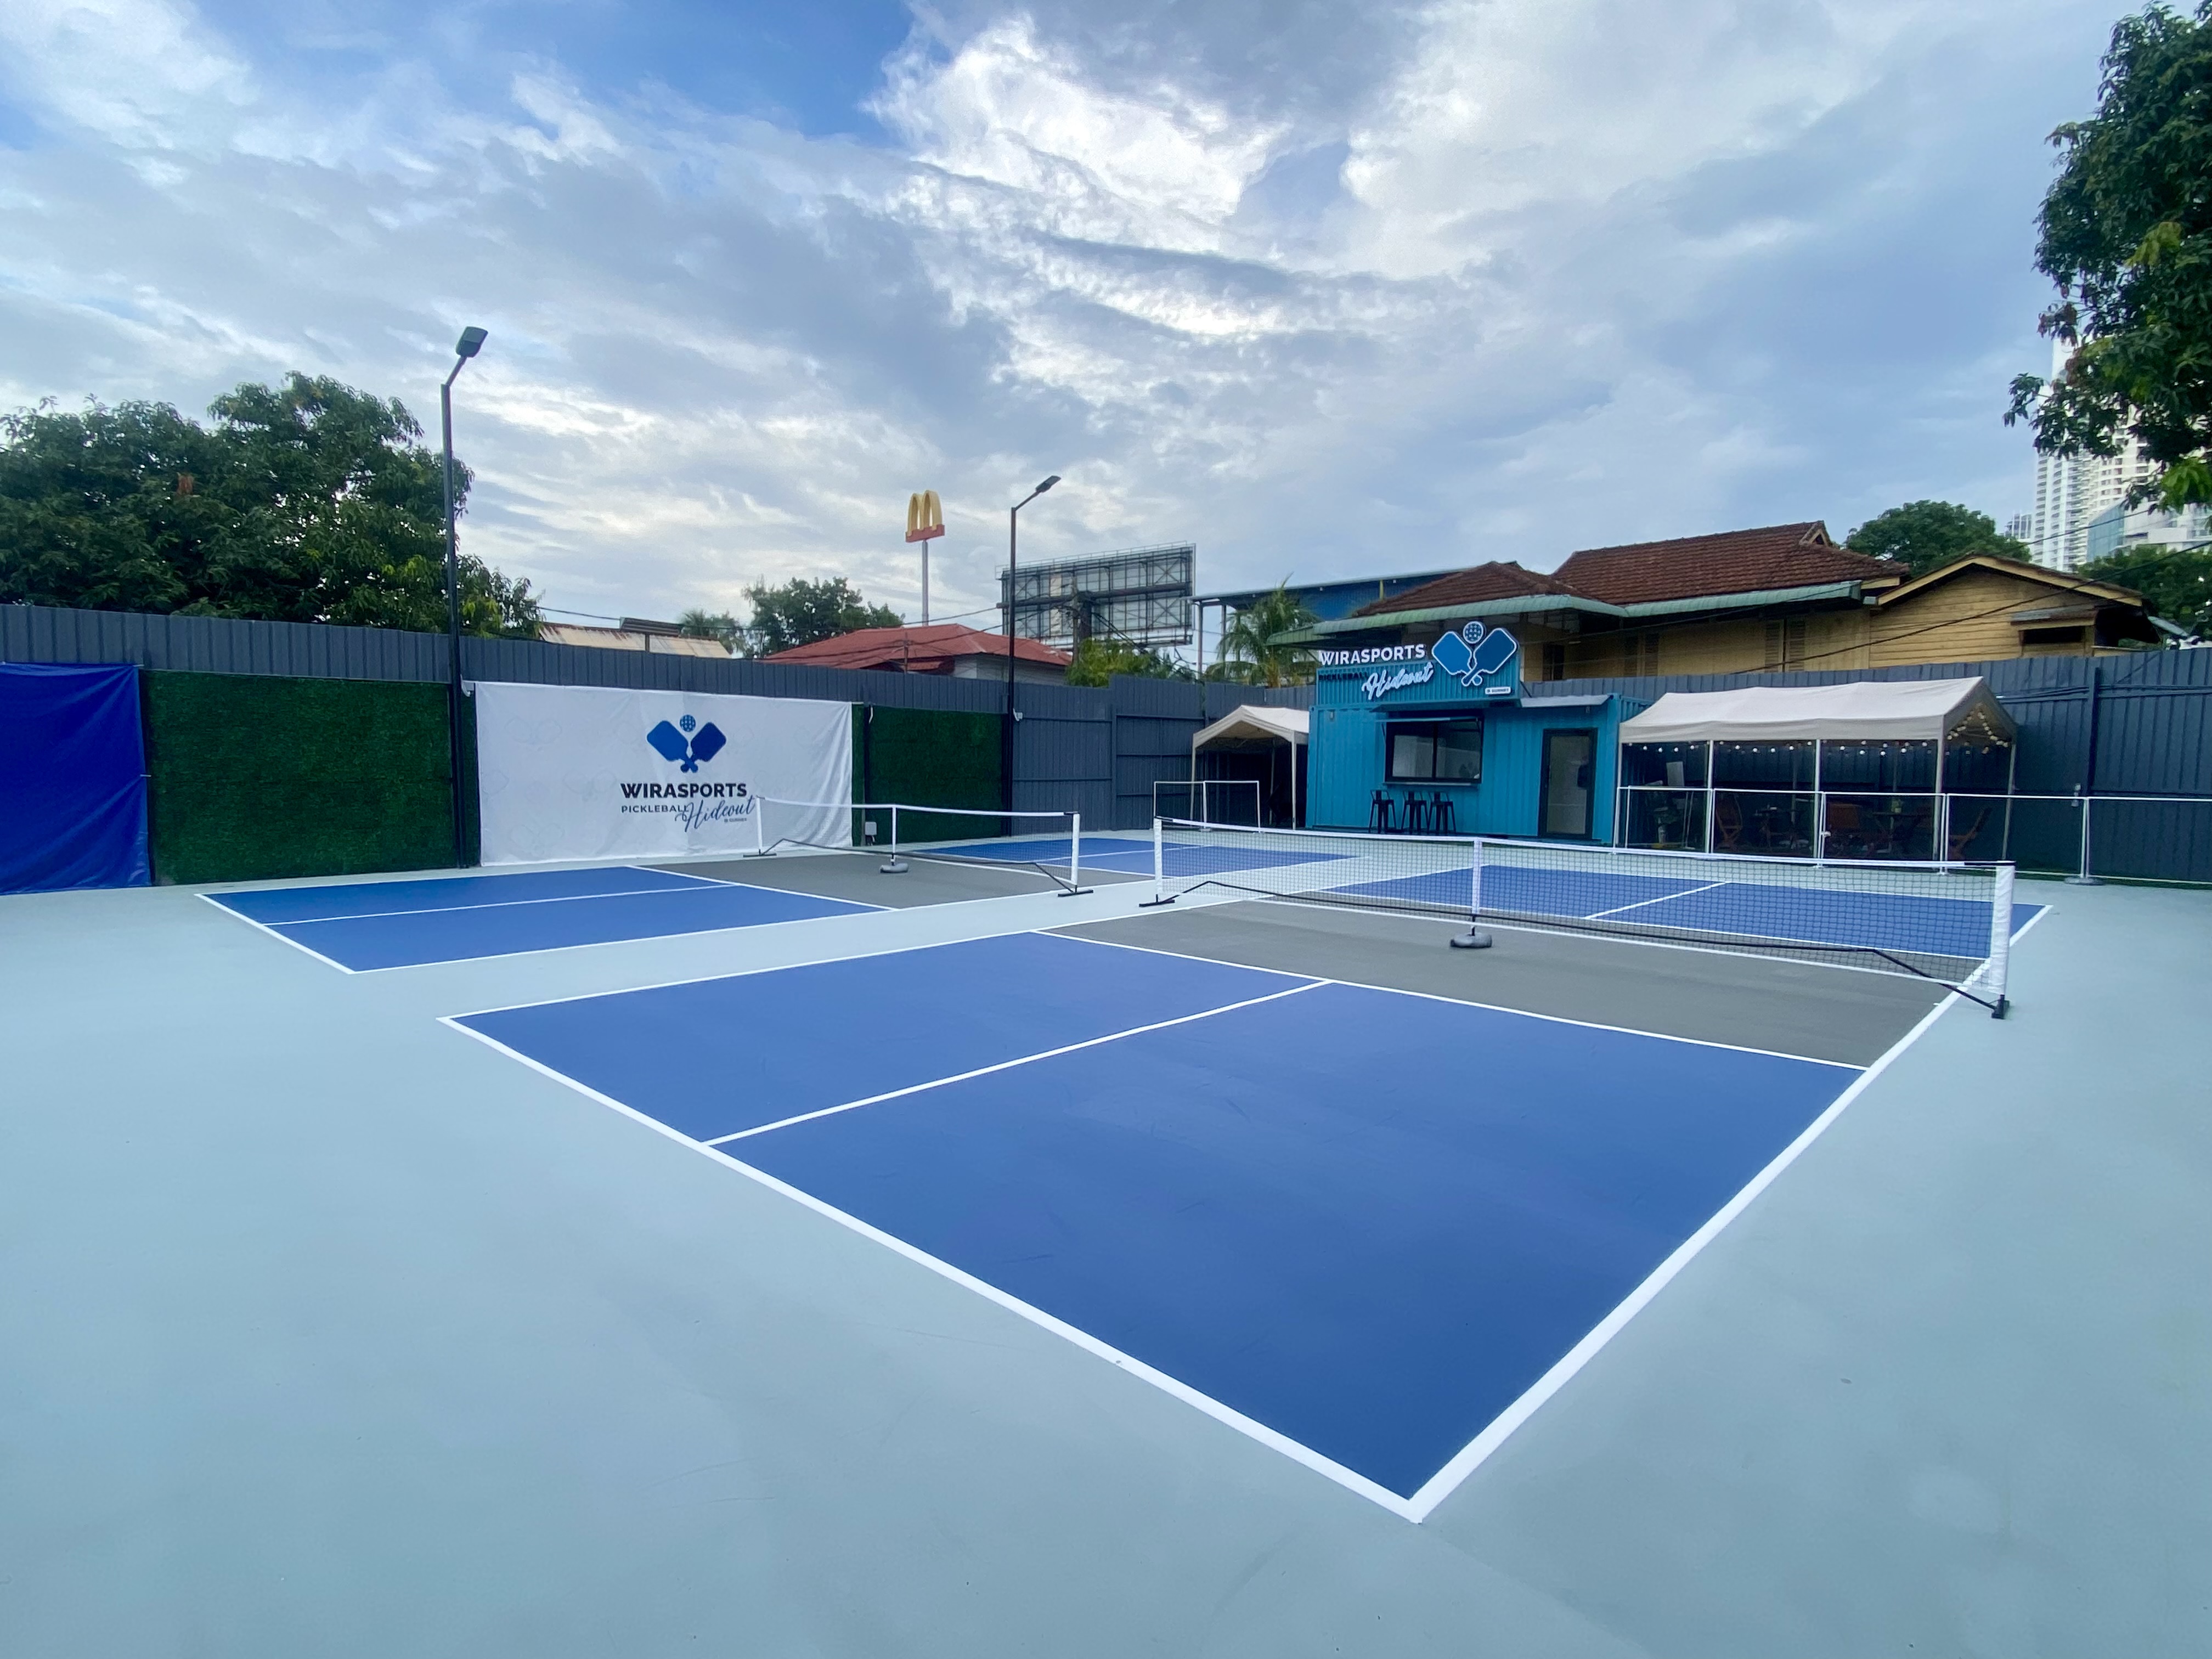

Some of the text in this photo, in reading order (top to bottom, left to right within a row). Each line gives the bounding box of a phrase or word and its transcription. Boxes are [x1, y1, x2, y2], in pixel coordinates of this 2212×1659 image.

[1318, 644, 1426, 666] WIRASPORTS
[620, 783, 747, 798] WIRASPORTS
[674, 795, 755, 832] Hideout
